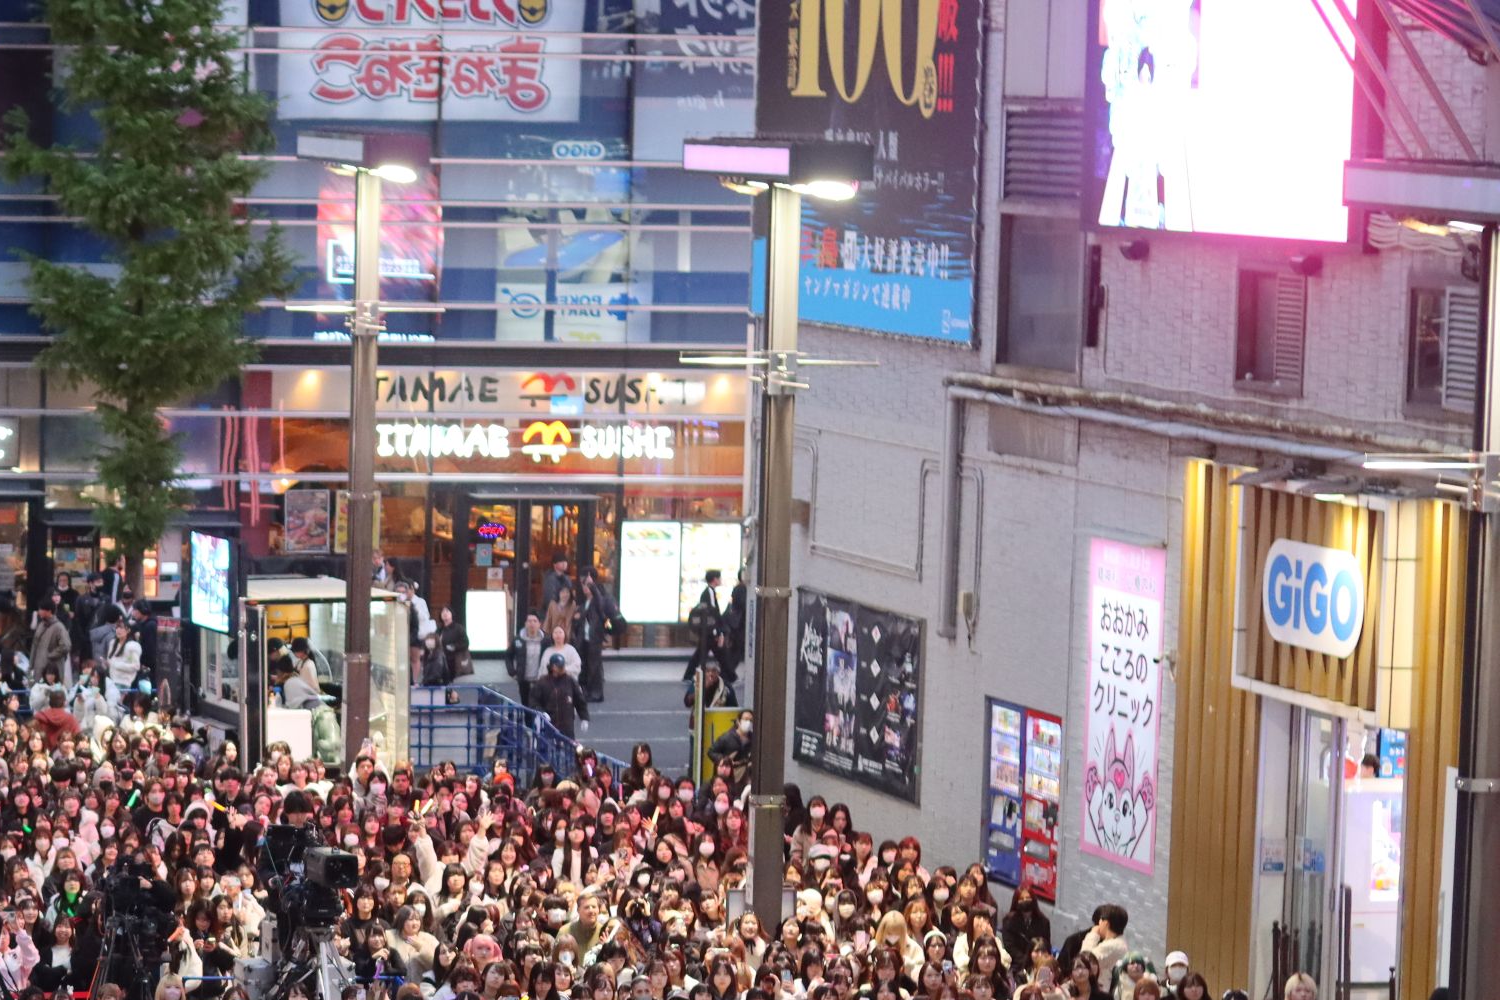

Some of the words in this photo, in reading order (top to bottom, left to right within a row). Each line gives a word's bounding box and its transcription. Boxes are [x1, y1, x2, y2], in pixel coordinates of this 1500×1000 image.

[375, 423, 510, 459] ITAMAE
[580, 425, 674, 460] SUSHI
[1100, 597, 1149, 641] おおかみ
[1268, 554, 1358, 642] GiGO
[1100, 643, 1149, 684] こころの
[1094, 680, 1154, 727] クリニック
